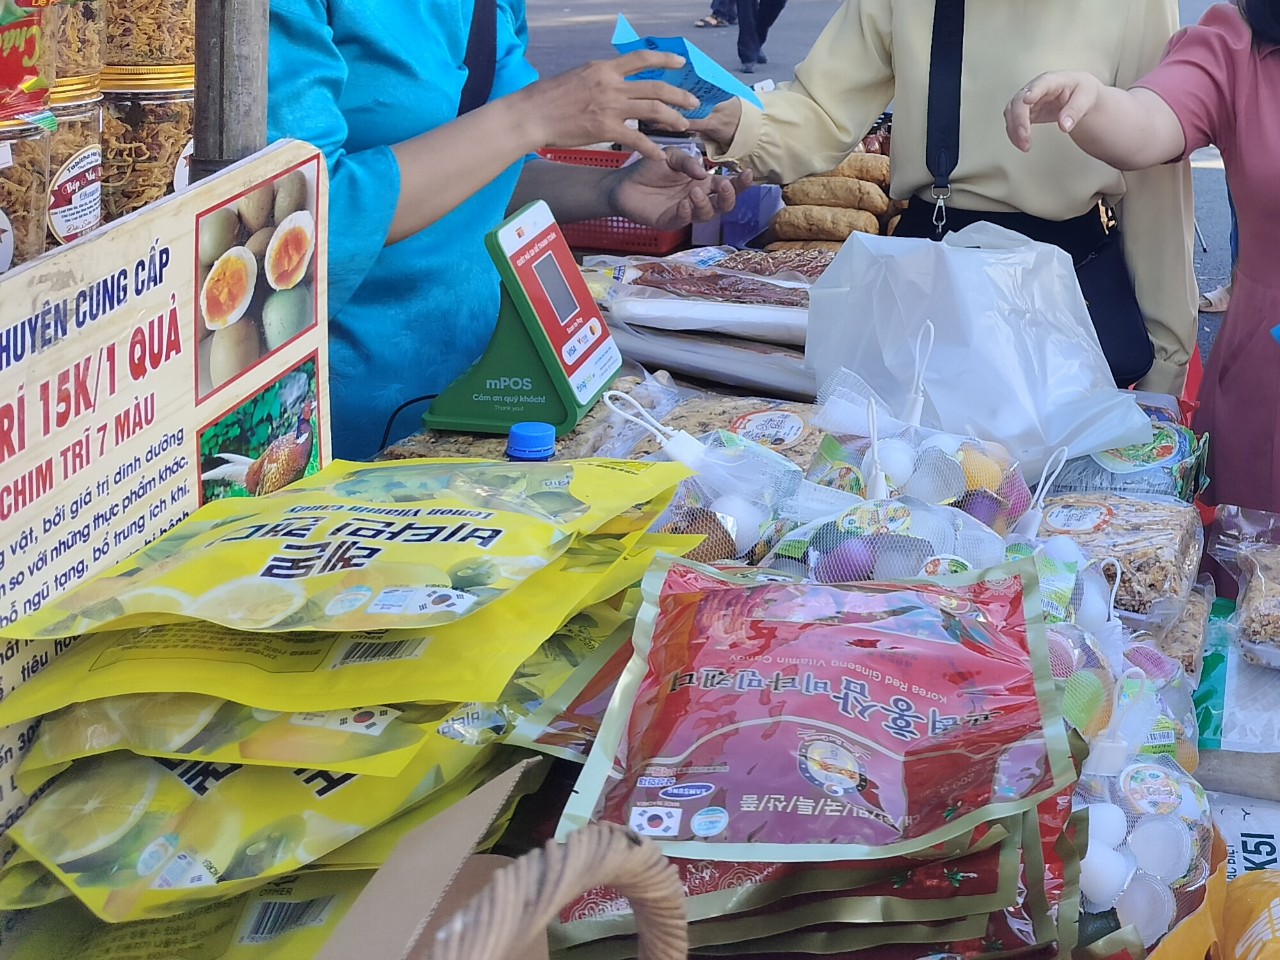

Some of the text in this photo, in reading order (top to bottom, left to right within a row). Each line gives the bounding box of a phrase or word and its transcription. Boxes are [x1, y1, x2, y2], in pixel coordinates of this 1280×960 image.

[75, 268, 128, 329] CUNG
[134, 238, 170, 297] CẤP
[39, 342, 116, 437] 15K/1
[129, 293, 182, 381] QUẢ
[486, 376, 533, 390] mPOS
[504, 395, 519, 403] quý
[0, 457, 53, 521] CHIM
[97, 423, 108, 457] 7
[115, 392, 155, 447] MÀU
[10, 428, 184, 556] vật, bởi giá trị dinh dưỡng
[347, 505, 423, 518] Vitamin
[9, 571, 25, 591] so
[28, 551, 47, 577] với
[51, 523, 90, 562] những
[93, 503, 120, 531] thực
[122, 475, 156, 515] phẩm
[427, 507, 494, 520] Lemon
[24, 581, 49, 614] ngũ
[54, 558, 89, 591] tạng,
[93, 531, 110, 562] bổ
[113, 514, 145, 547] trung
[149, 497, 167, 521] ích
[171, 478, 190, 505] khí.
[259, 540, 383, 580] 레몬
[21, 651, 49, 682] tiêu
[729, 654, 948, 704] Korea Red Ginseng Vitamin Candy
[667, 787, 707, 796] SAMSUNG
[259, 887, 293, 897] OTHER
